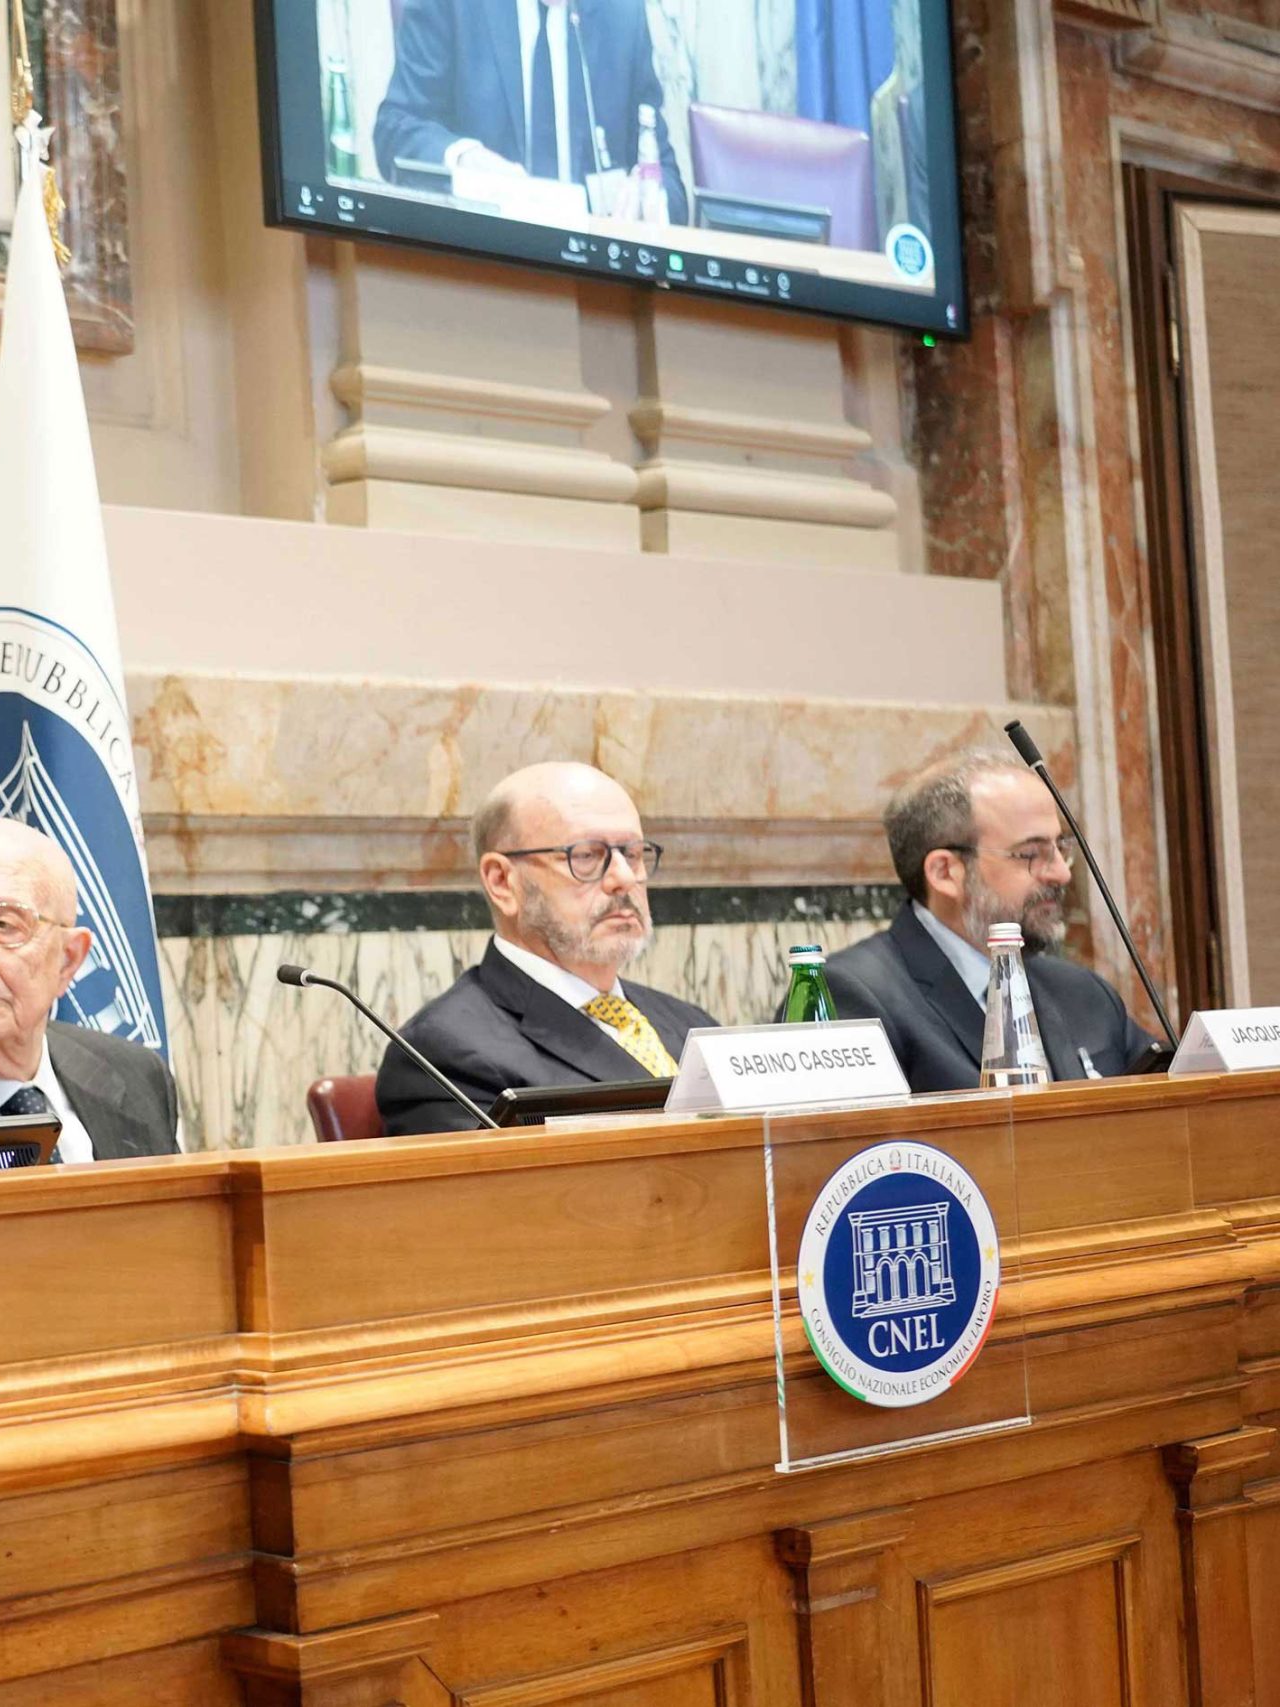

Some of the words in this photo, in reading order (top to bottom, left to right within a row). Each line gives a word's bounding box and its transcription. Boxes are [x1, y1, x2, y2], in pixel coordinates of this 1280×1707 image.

[729, 1052, 797, 1076] SABINO
[798, 1047, 876, 1071] CASSESE
[815, 1157, 885, 1236] REPUBBLICA
[907, 1153, 973, 1208] ITALIANA
[811, 1307, 857, 1381] CONSIGLIO
[857, 1373, 918, 1396] NAZIONALE
[919, 1344, 970, 1391] ECONOMIA
[971, 1280, 993, 1338] LAVORO
[867, 1313, 946, 1358] CNEL
